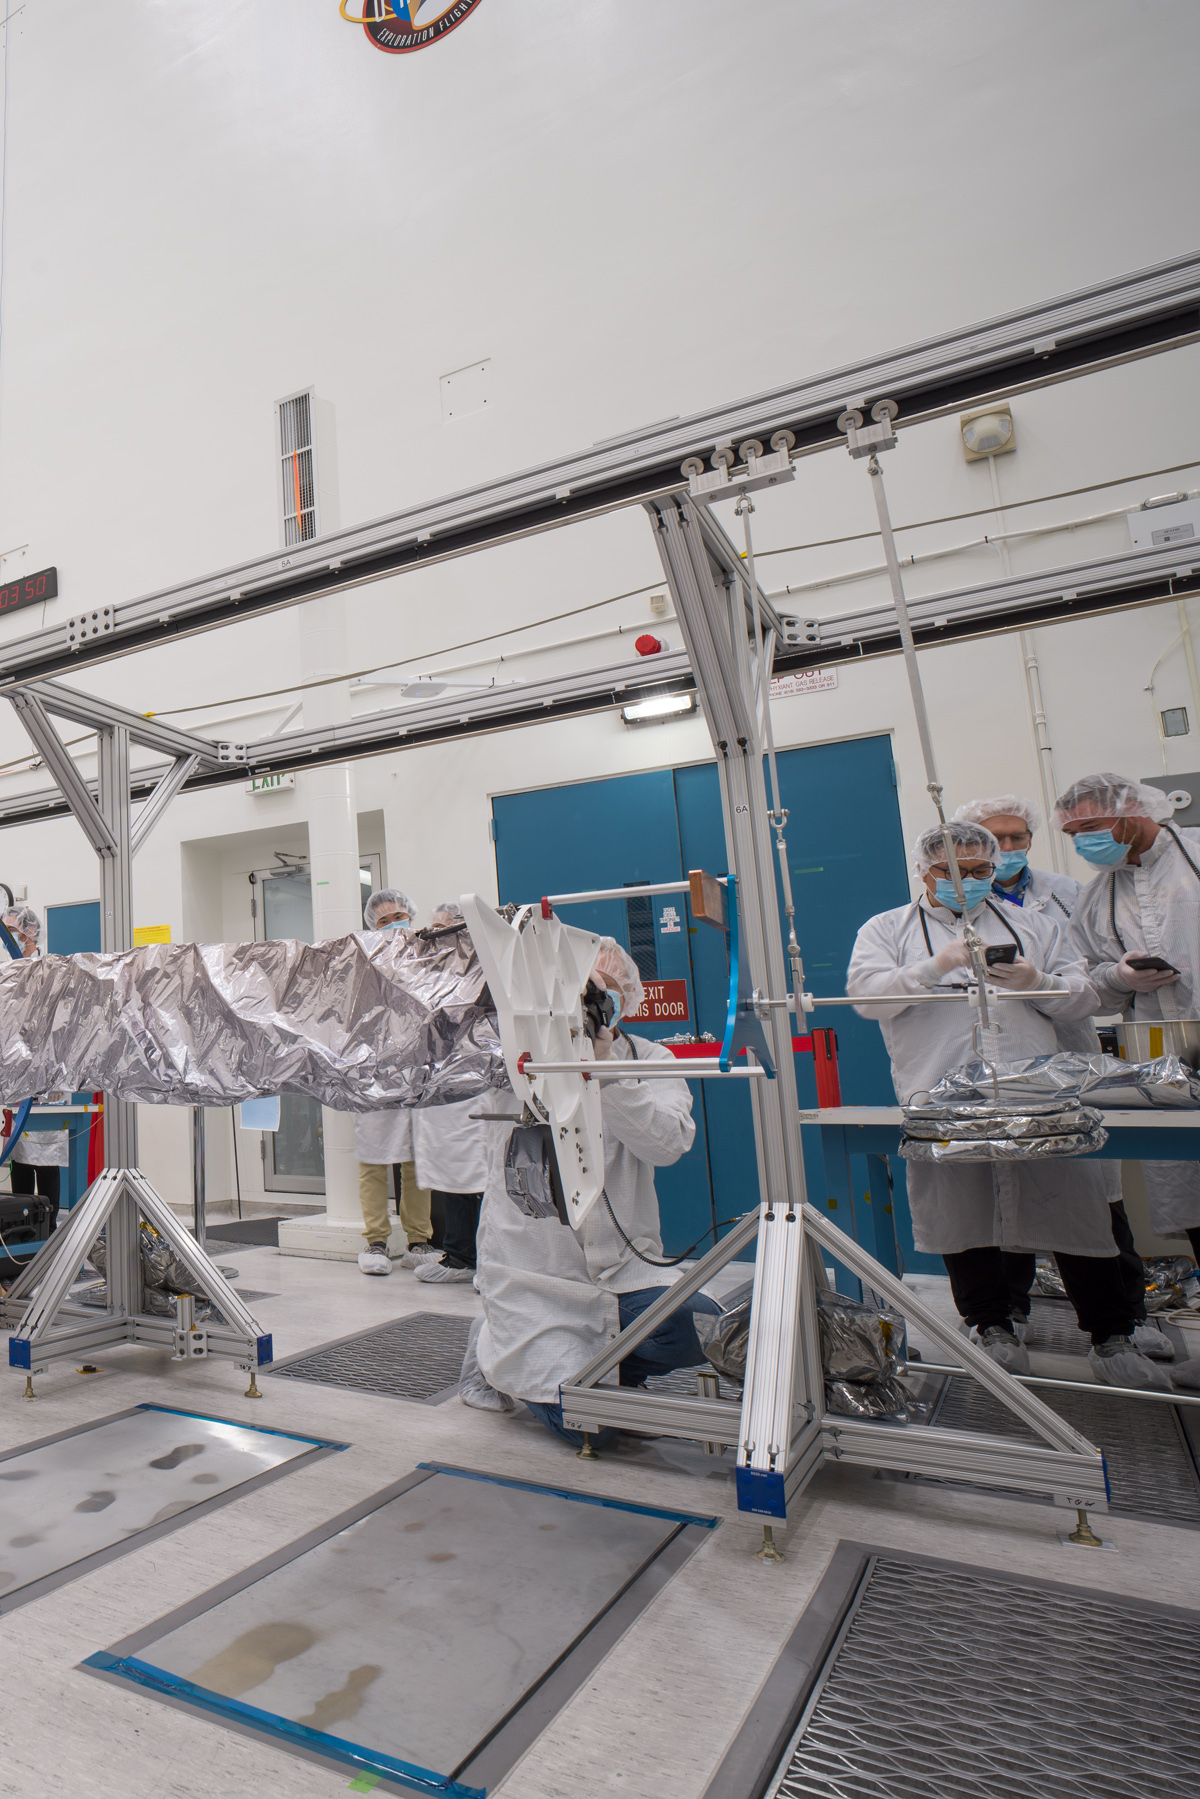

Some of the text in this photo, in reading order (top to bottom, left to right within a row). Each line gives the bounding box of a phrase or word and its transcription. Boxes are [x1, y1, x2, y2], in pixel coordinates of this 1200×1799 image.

[377, 27, 434, 46] EXPLORATION
[795, 680, 808, 688] GAS
[809, 675, 835, 684] RELEASE
[735, 805, 749, 814] 6A
[643, 986, 664, 999] EXIT
[654, 1002, 684, 1016] DOOR
